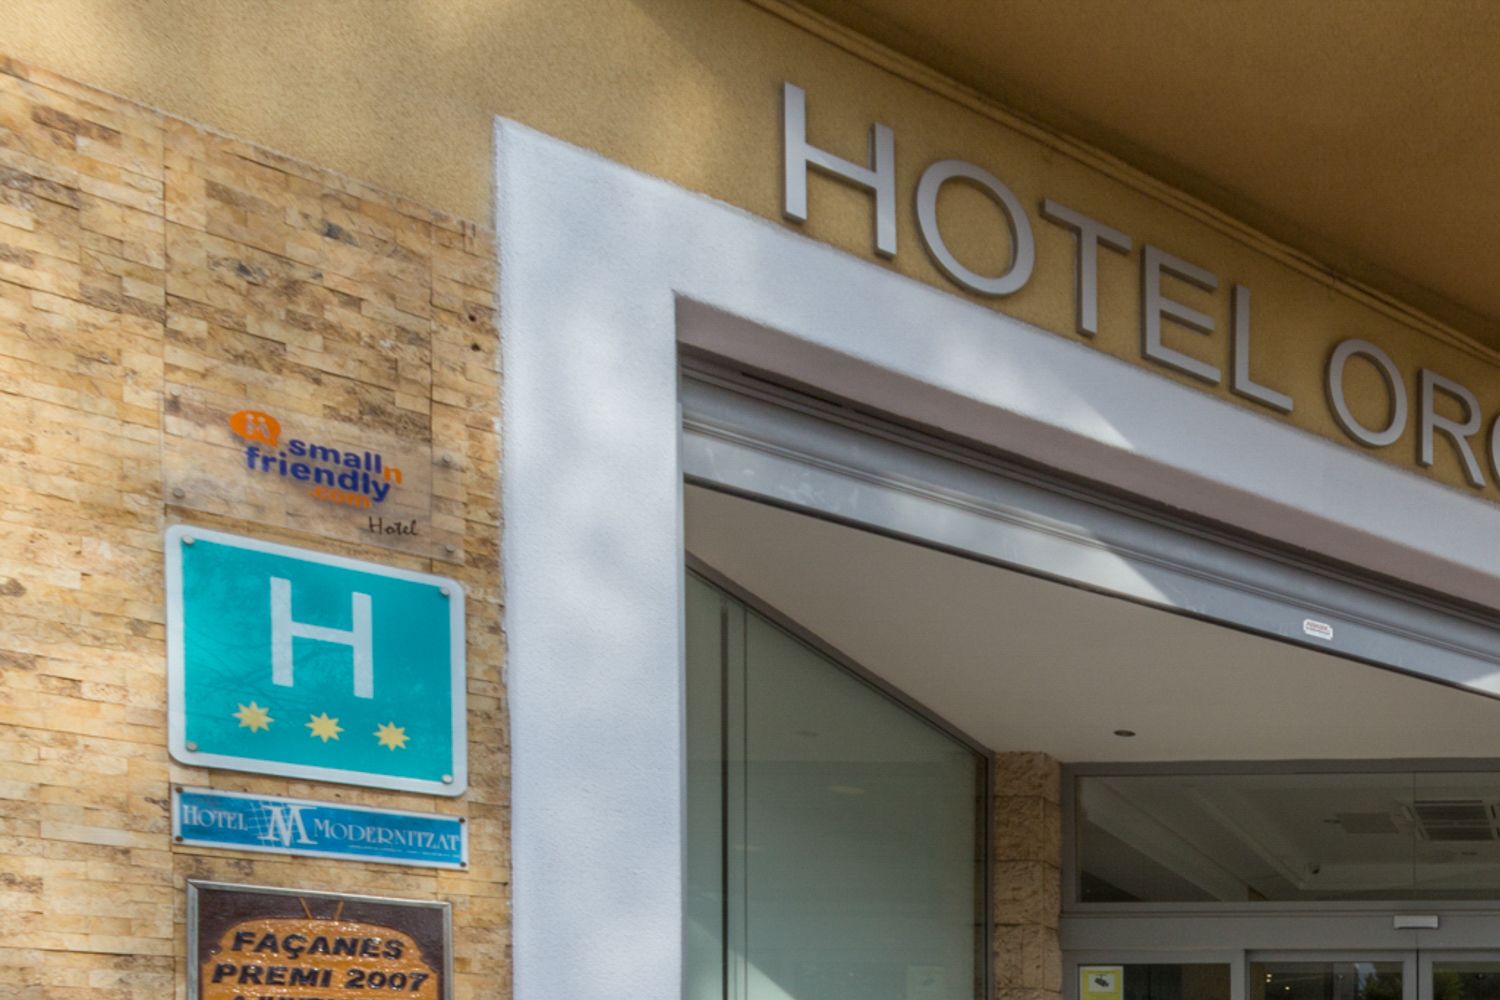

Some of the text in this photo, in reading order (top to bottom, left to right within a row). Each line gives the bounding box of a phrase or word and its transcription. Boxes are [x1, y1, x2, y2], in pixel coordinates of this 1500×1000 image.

[781, 80, 1293, 414] HOTEL
[246, 446, 391, 503] friendly
[368, 515, 418, 536] Hotel
[270, 576, 374, 700] H
[232, 931, 406, 960] FAÇANES
[211, 962, 430, 992] PREMI 2007
